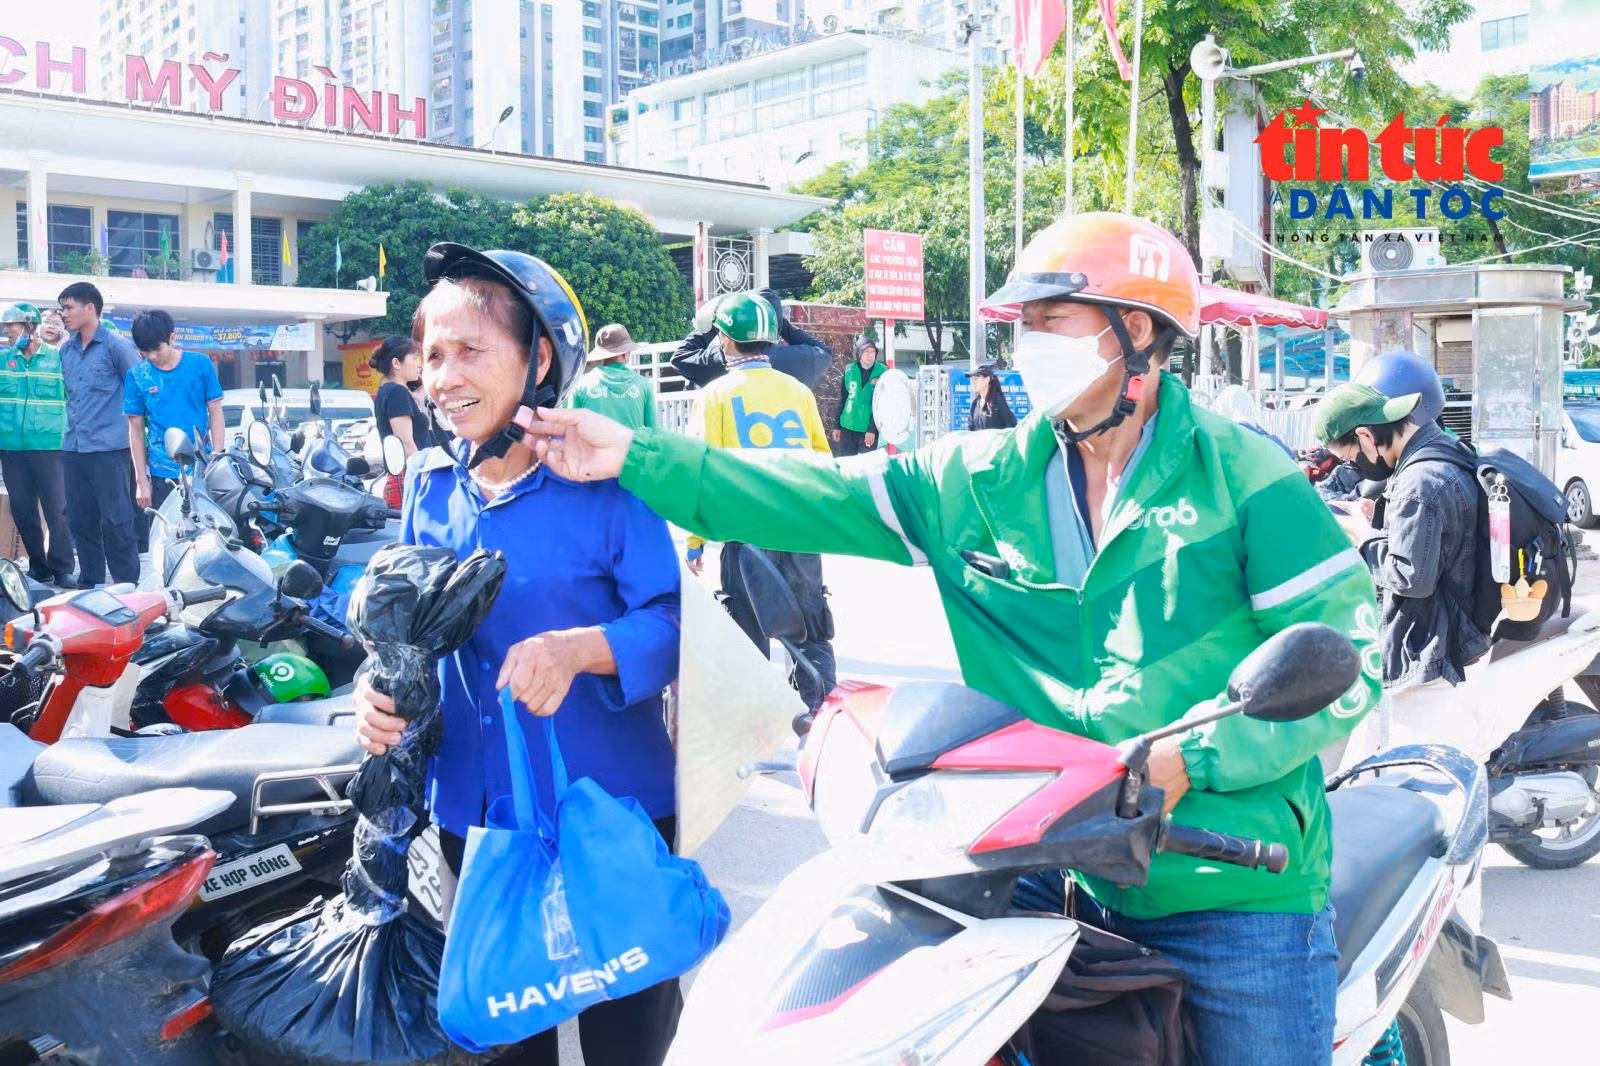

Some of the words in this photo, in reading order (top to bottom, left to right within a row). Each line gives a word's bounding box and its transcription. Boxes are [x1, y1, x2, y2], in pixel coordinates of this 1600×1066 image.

[824, 14, 838, 34] 9
[125, 51, 241, 111] MỸ
[269, 65, 426, 139] ĐÌNH
[732, 396, 808, 449] be
[204, 878, 221, 894] XE
[220, 868, 248, 887] HỢP
[249, 855, 290, 878] ĐỒNG
[487, 946, 649, 1018] HAVEN'S
